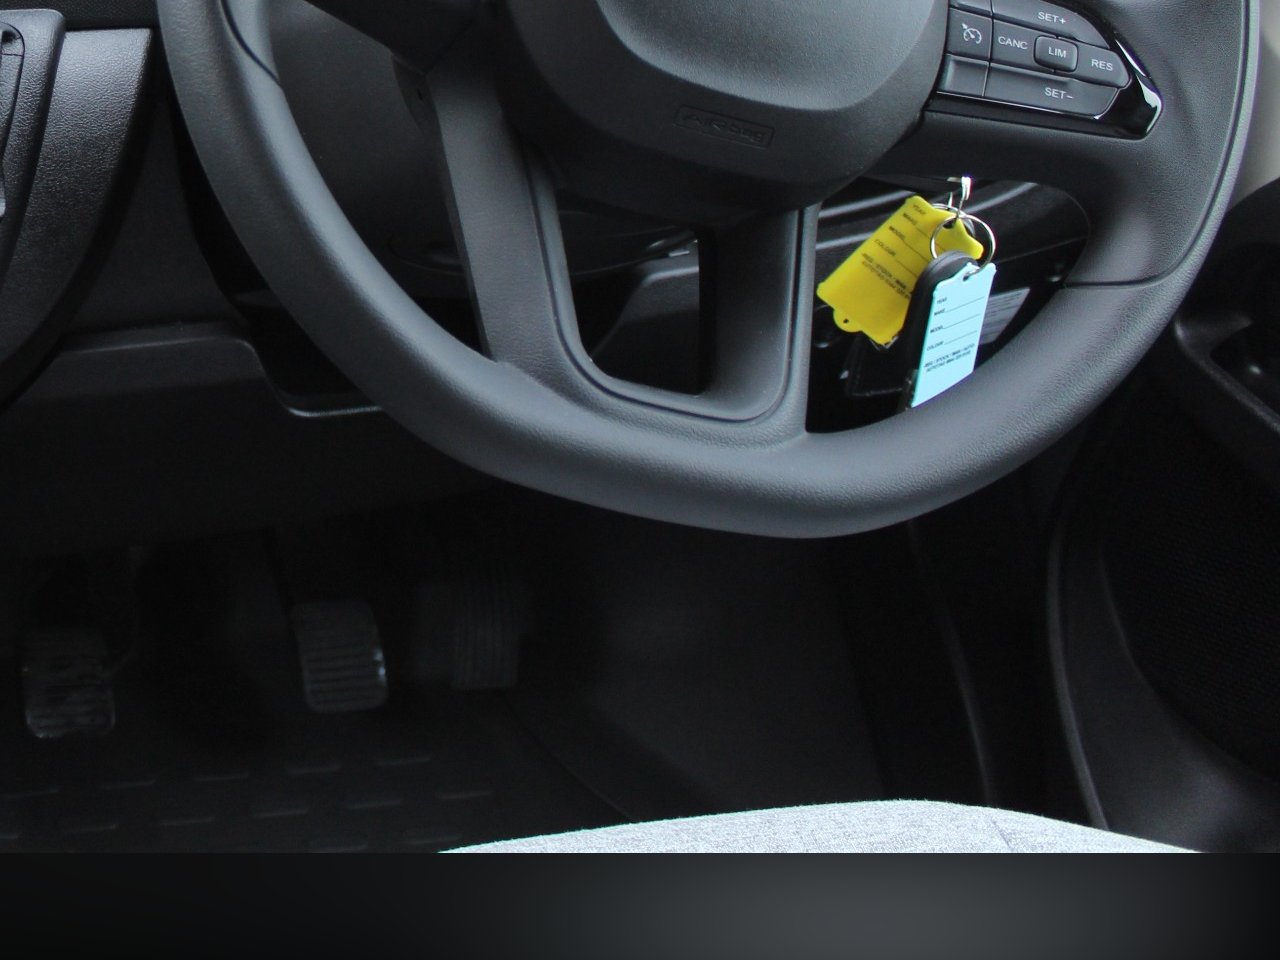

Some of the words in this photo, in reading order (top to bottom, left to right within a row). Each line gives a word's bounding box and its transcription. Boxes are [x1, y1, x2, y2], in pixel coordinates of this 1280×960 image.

[998, 35, 1028, 50] CANC
[1048, 46, 1067, 58] LIM
[1091, 58, 1113, 72] RES
